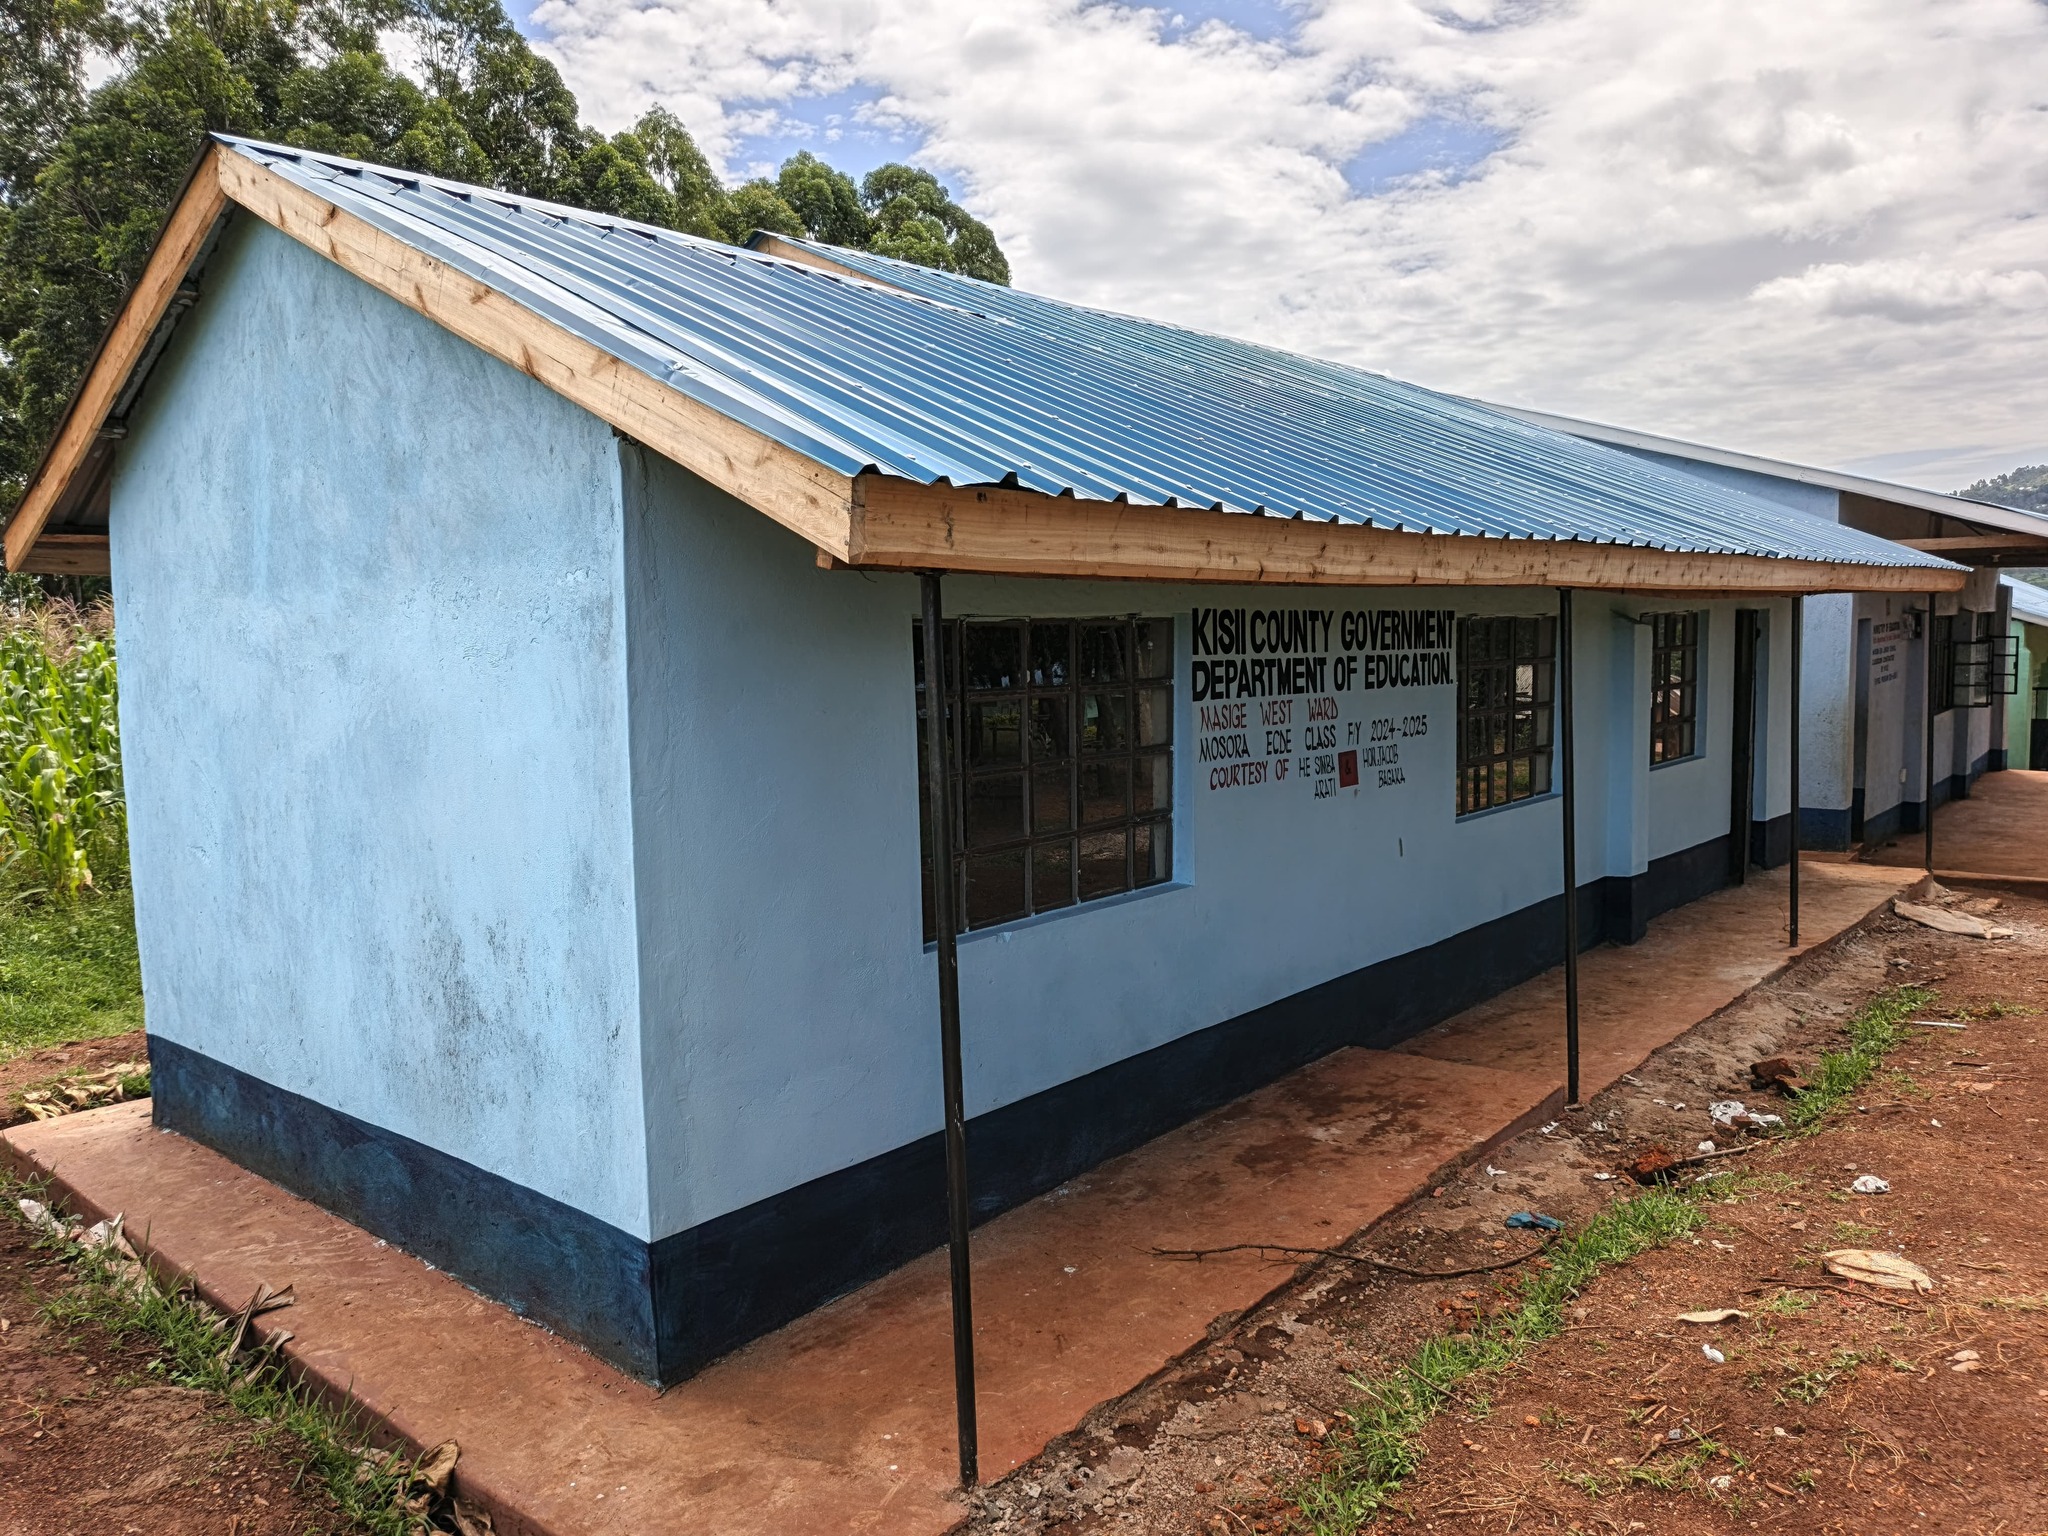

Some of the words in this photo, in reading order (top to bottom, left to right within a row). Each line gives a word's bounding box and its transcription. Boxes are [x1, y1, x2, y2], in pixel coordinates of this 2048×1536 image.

[1192, 607, 1245, 656] KISII
[1250, 609, 1334, 655] COUNTY
[1341, 609, 1455, 652] GOVERNMENT
[1192, 657, 1327, 702] DEPARTMENT
[1334, 656, 1358, 692] OF
[1365, 652, 1453, 690] EDUCATION.
[1200, 702, 1247, 733] MASIGE
[1260, 699, 1293, 726] WEST
[1307, 696, 1338, 722] WARD
[1198, 733, 1250, 763] MOSORA
[1265, 728, 1292, 756] ECDE
[1304, 724, 1336, 751] CLASS
[1210, 760, 1268, 791] COURTESY
[1275, 758, 1289, 781] OF
[1344, 758, 1352, 775] &
[1314, 777, 1336, 800] ARATI
